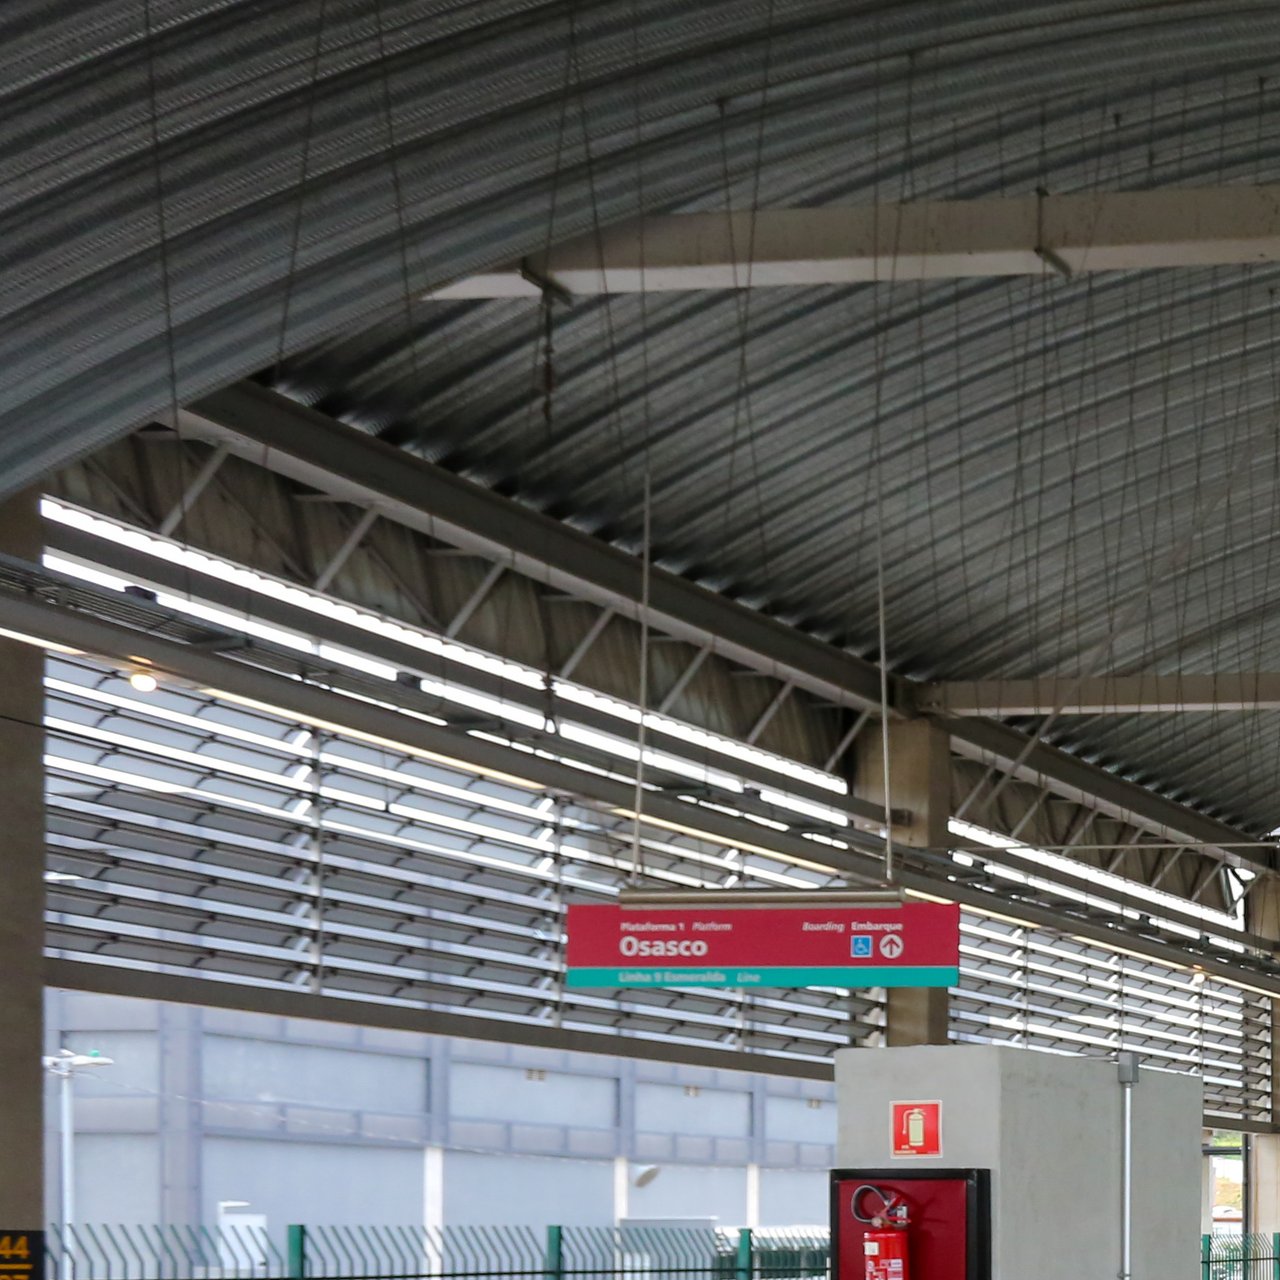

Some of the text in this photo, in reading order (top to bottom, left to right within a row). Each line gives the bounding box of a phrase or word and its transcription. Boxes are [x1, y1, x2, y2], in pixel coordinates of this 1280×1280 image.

[620, 921, 676, 931] Plataforma
[692, 922, 732, 931] Platform
[802, 921, 903, 933] Boarding Embarque
[619, 935, 708, 957] Osasco
[0, 1236, 31, 1259] 44
